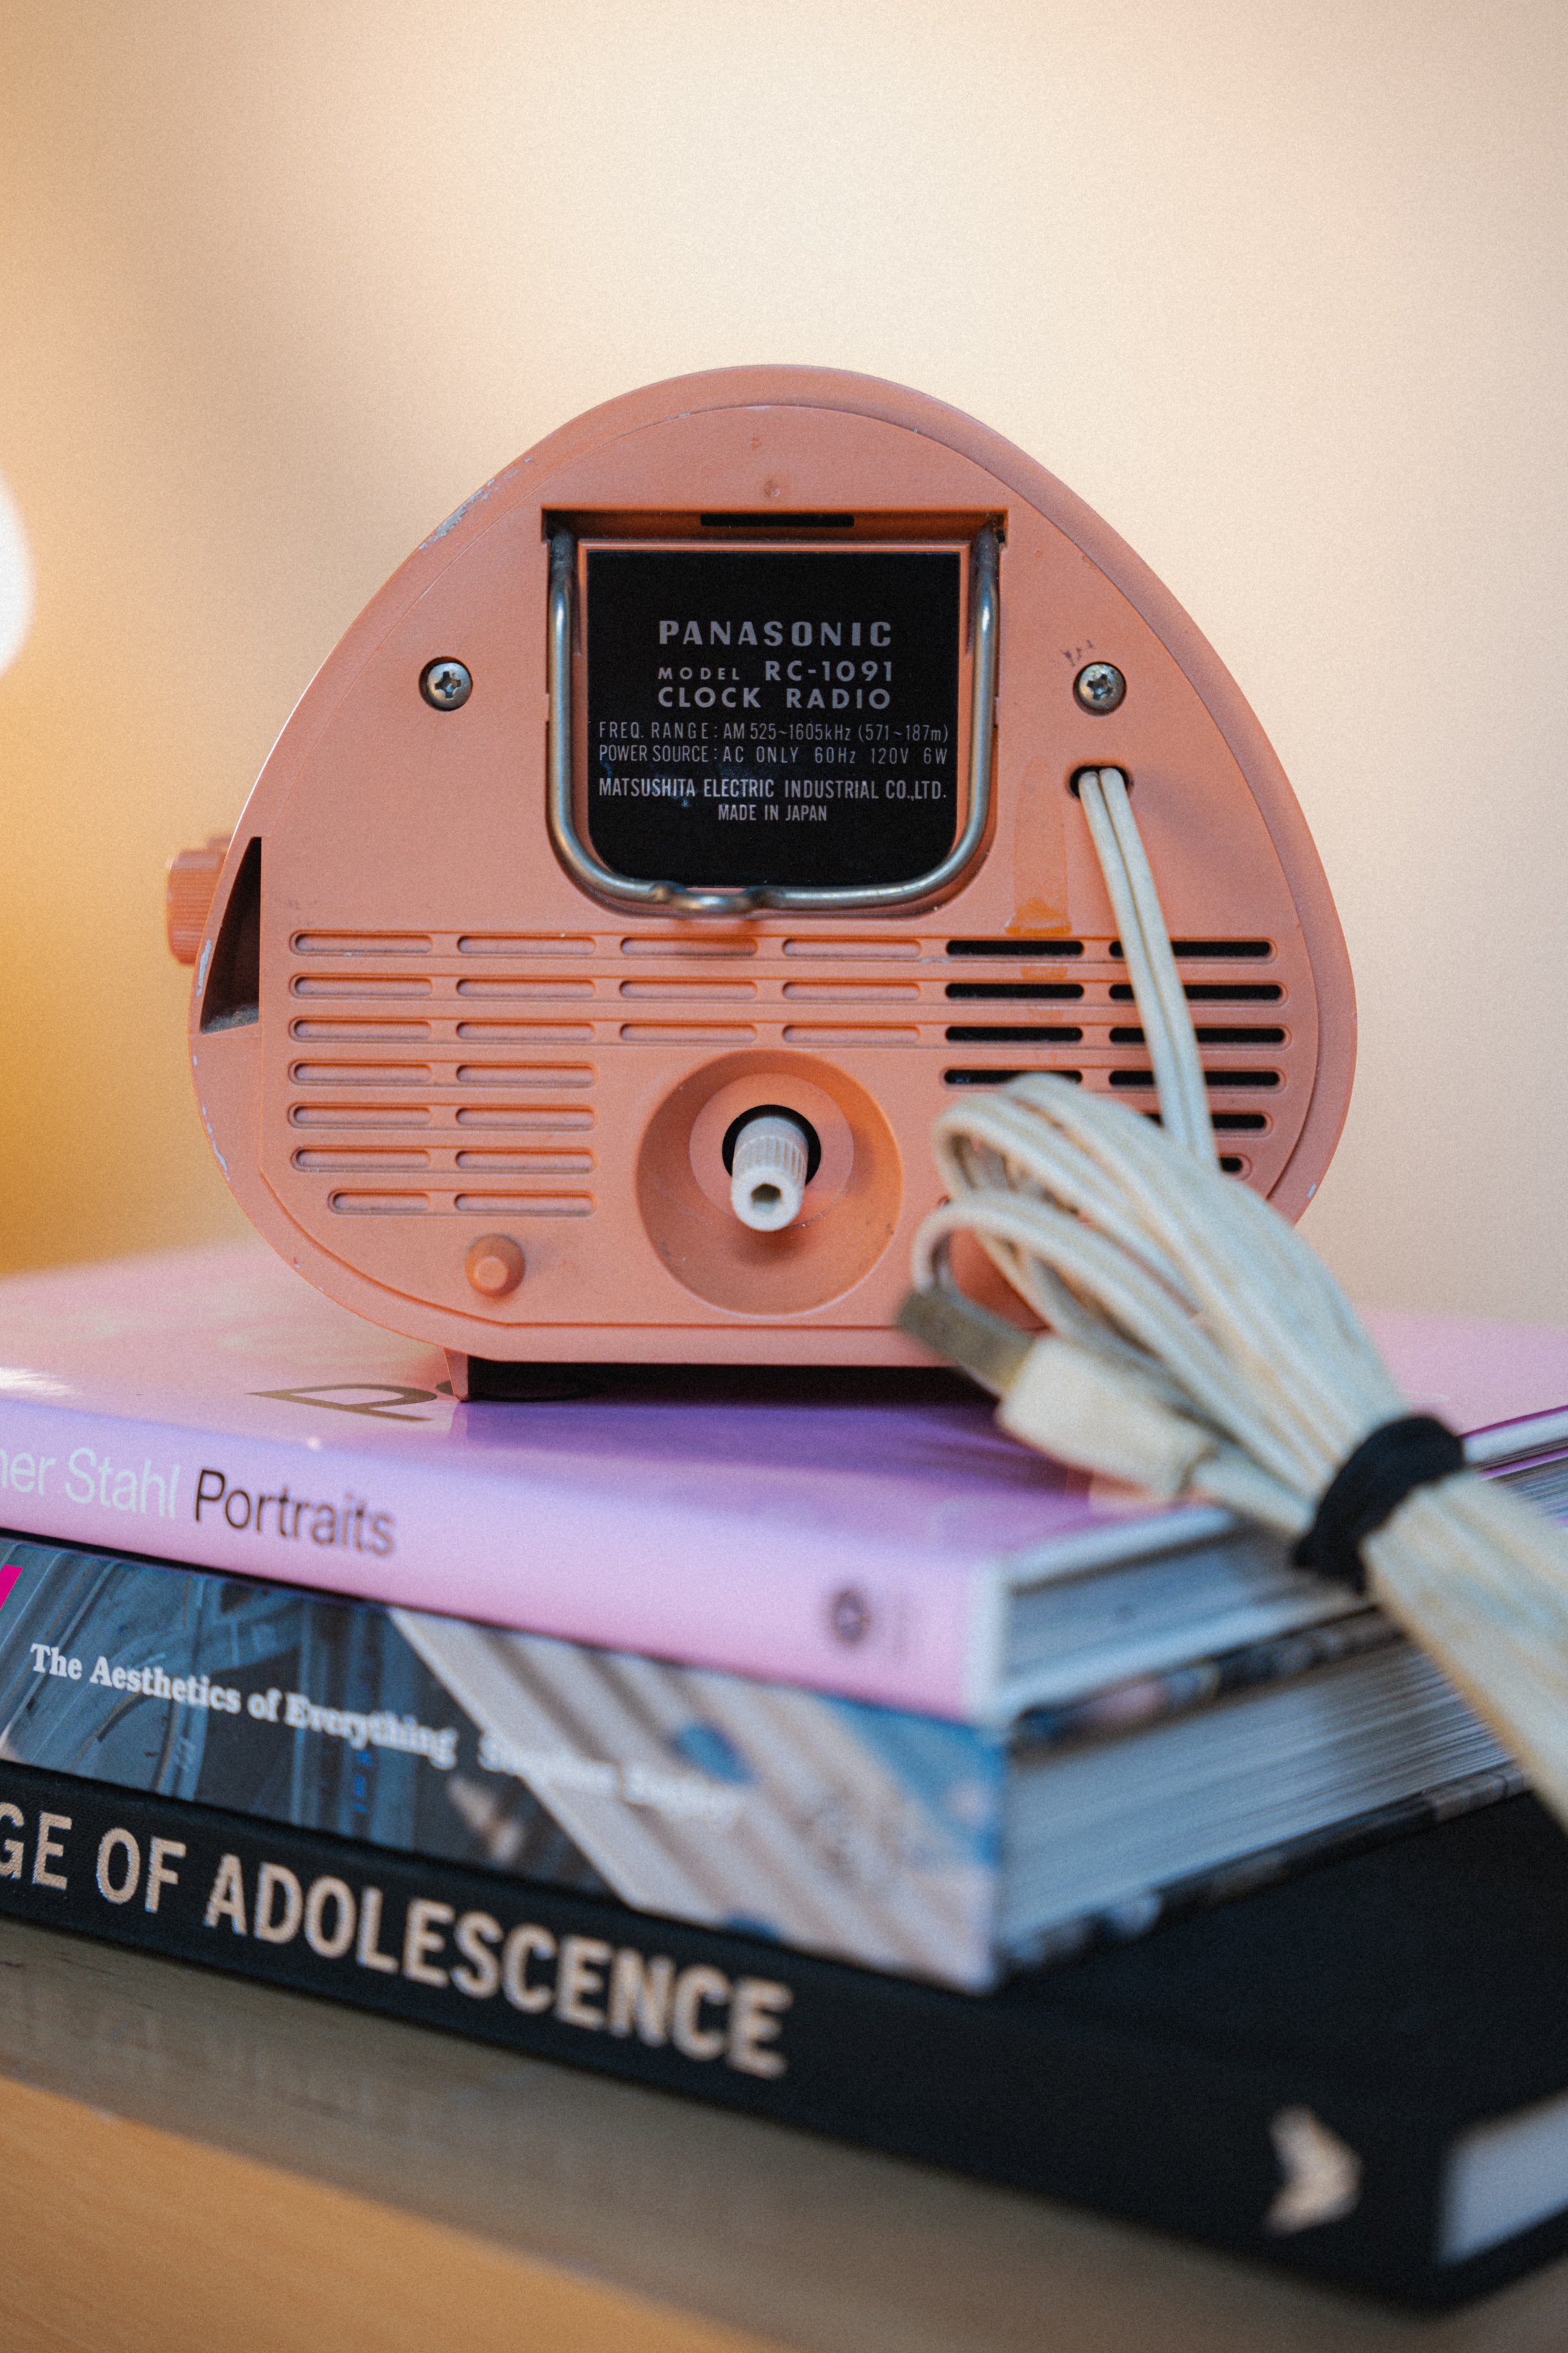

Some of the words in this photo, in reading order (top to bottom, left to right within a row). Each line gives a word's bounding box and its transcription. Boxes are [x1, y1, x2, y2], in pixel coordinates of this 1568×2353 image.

[659, 620, 891, 647] PANASONIC
[658, 667, 739, 680] MODEL
[765, 660, 891, 682] RC-1091
[658, 687, 761, 708] CLOCK
[787, 688, 890, 709] RADIO
[600, 721, 645, 738] FREQ.
[724, 723, 745, 739] AM
[599, 744, 648, 761] POWER
[723, 746, 744, 763] AC
[756, 746, 798, 763] ONLY
[815, 746, 855, 764] 60Hz
[872, 747, 908, 764] 120V
[923, 747, 947, 764] 6W
[599, 777, 696, 797] MATSUSHITA
[704, 778, 774, 798] ELECTRIC
[785, 780, 878, 799] INDUSTRIAL
[718, 803, 756, 821] MADE
[764, 805, 779, 820] IN
[786, 805, 827, 821] JAPAN
[65, 1447, 181, 1520] Stahl
[195, 1468, 394, 1556] Portraits
[30, 1643, 83, 1680] The
[89, 1655, 242, 1714] Aesthetics
[247, 1687, 282, 1723] of
[284, 1691, 459, 1771] Everything
[97, 1827, 187, 1914] OF
[204, 1853, 792, 2079] ADOLESCENCE
